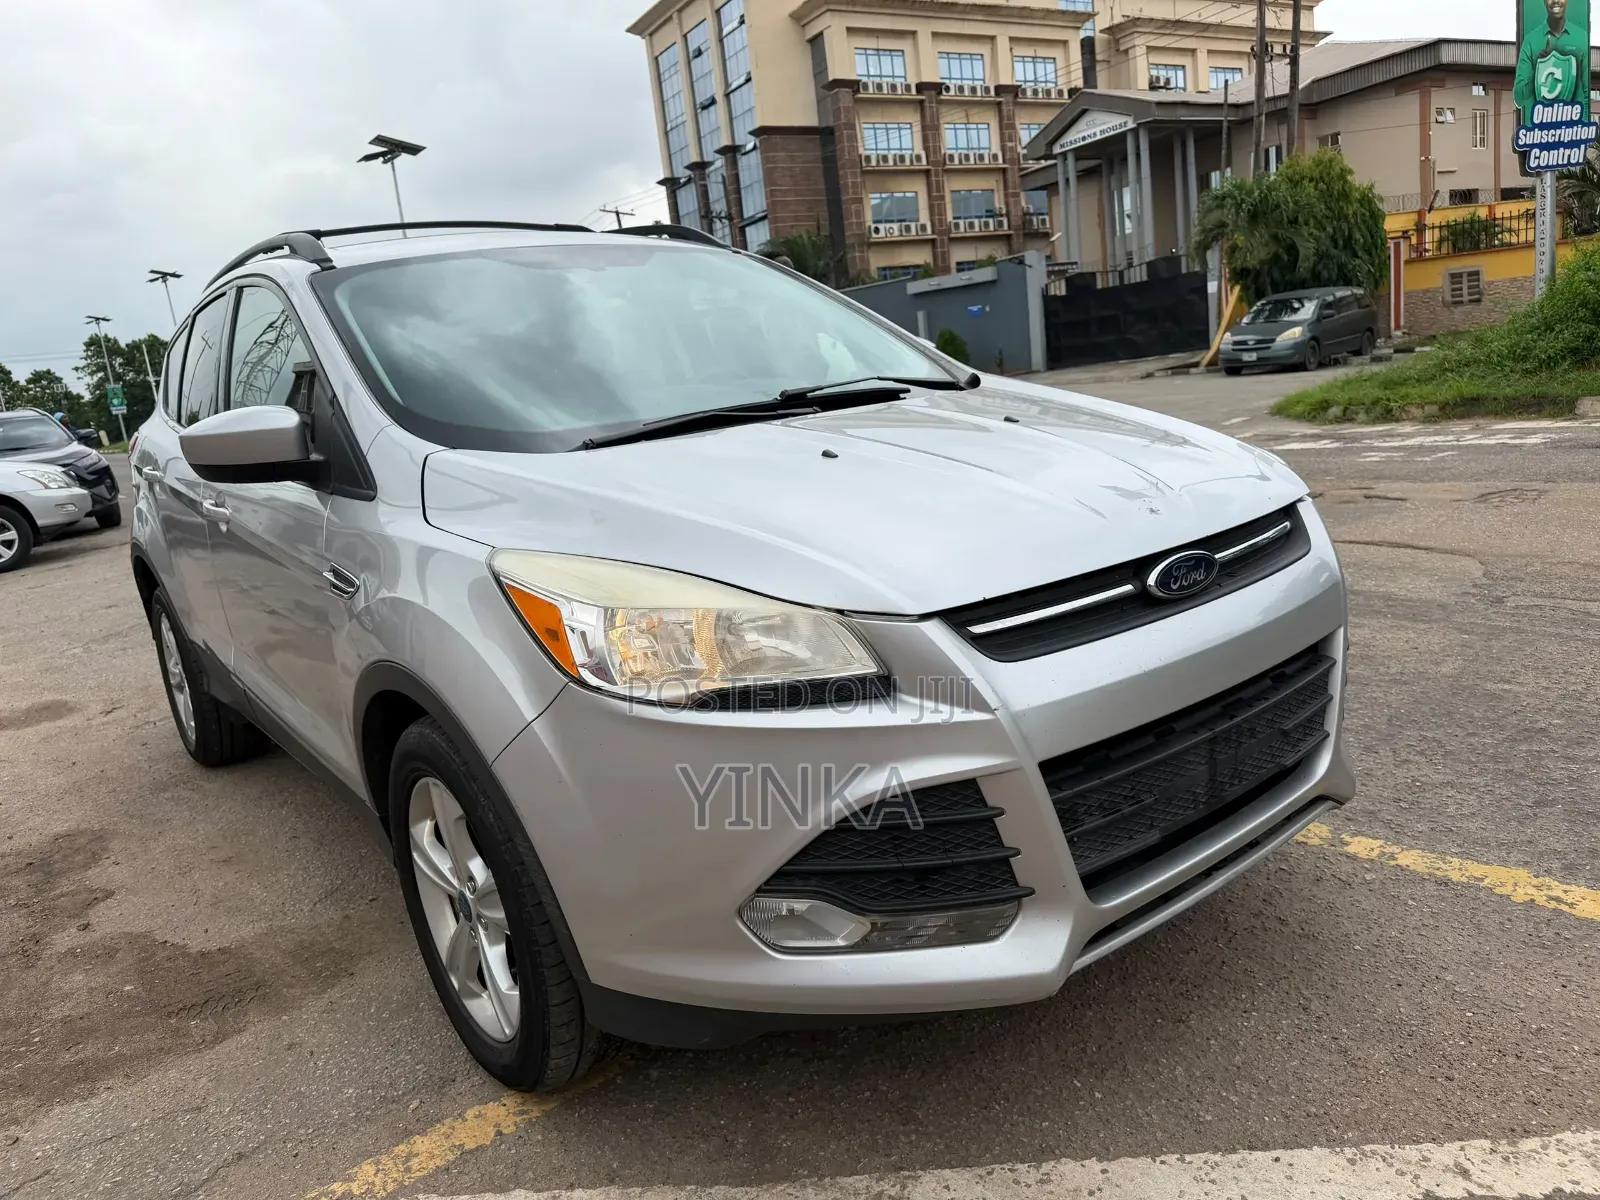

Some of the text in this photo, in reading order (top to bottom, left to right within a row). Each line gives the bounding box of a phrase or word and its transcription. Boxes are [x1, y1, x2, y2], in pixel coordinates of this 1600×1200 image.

[1533, 103, 1581, 124] Online
[1059, 120, 1129, 150] MISSIONS HOUSE
[1518, 125, 1596, 145] Subscription
[1529, 144, 1585, 167] Control
[1170, 559, 1206, 590] Ford
